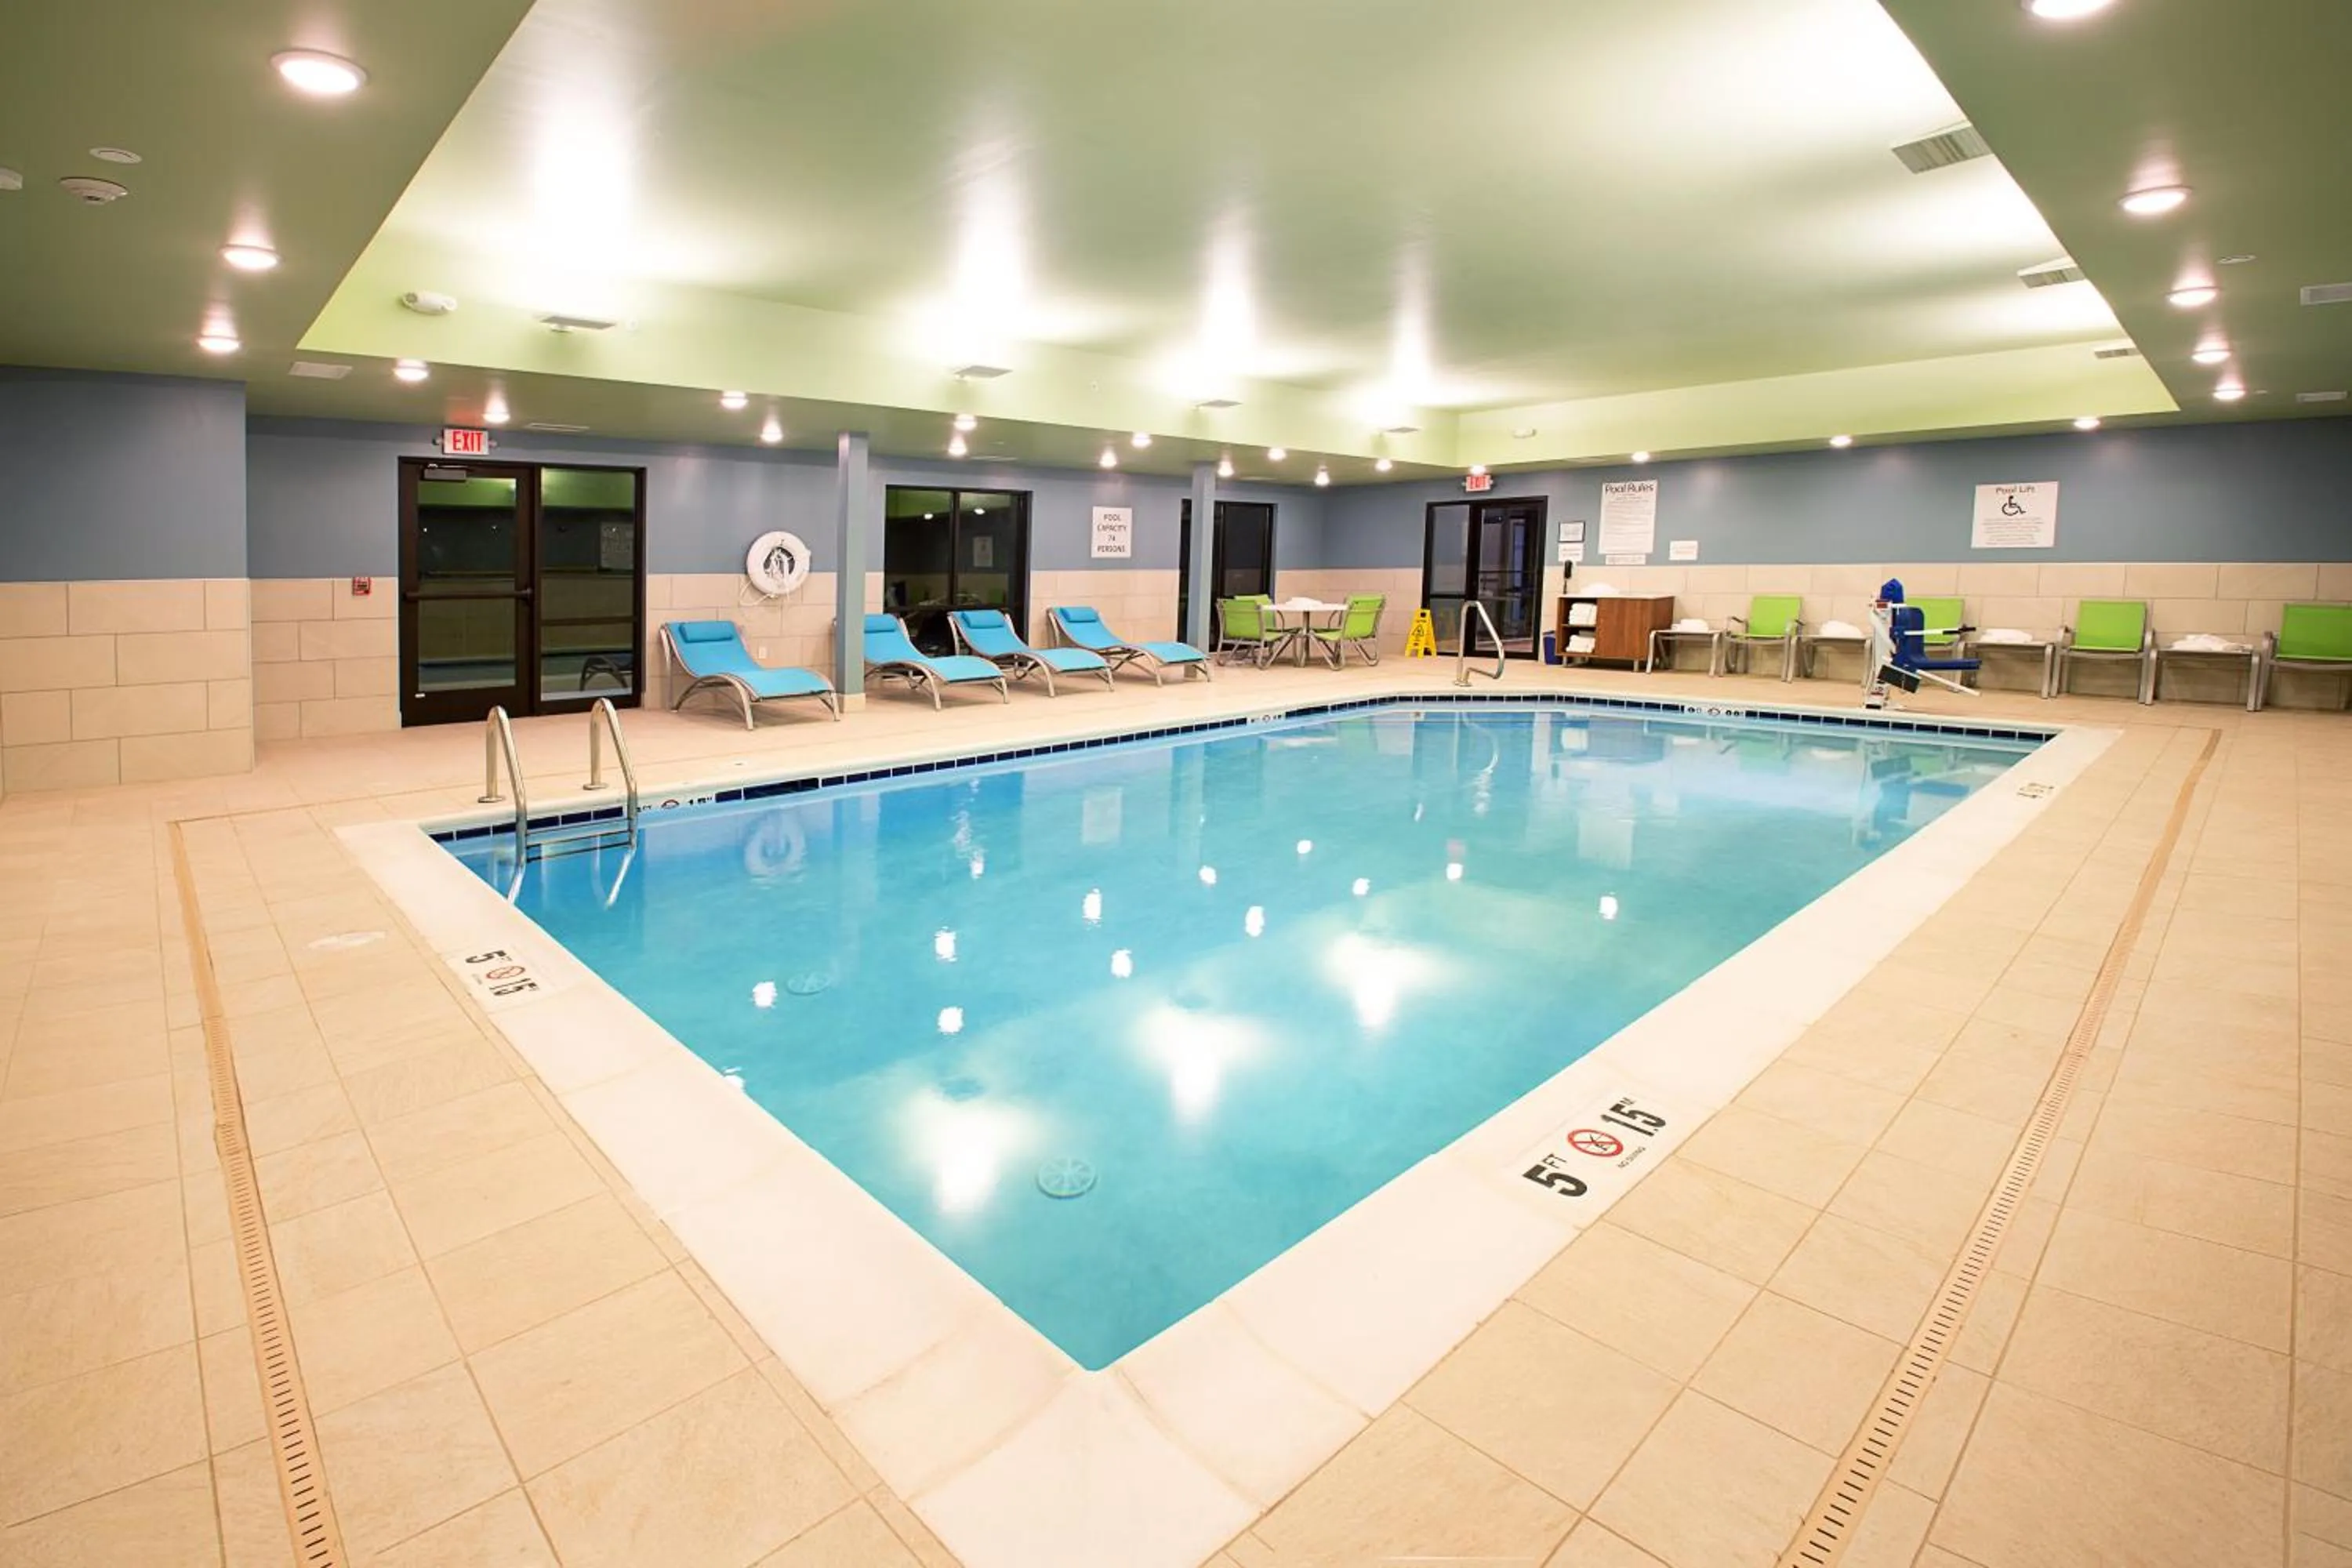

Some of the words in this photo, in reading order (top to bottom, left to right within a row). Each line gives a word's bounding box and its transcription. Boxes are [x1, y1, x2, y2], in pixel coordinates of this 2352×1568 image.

[452, 430, 484, 452] EXIT
[1470, 476, 1486, 489] EXIT
[1605, 484, 1626, 493] Pool
[1628, 482, 1654, 492] Rules
[1097, 524, 1127, 532] CAPACITY
[466, 950, 506, 964] 5
